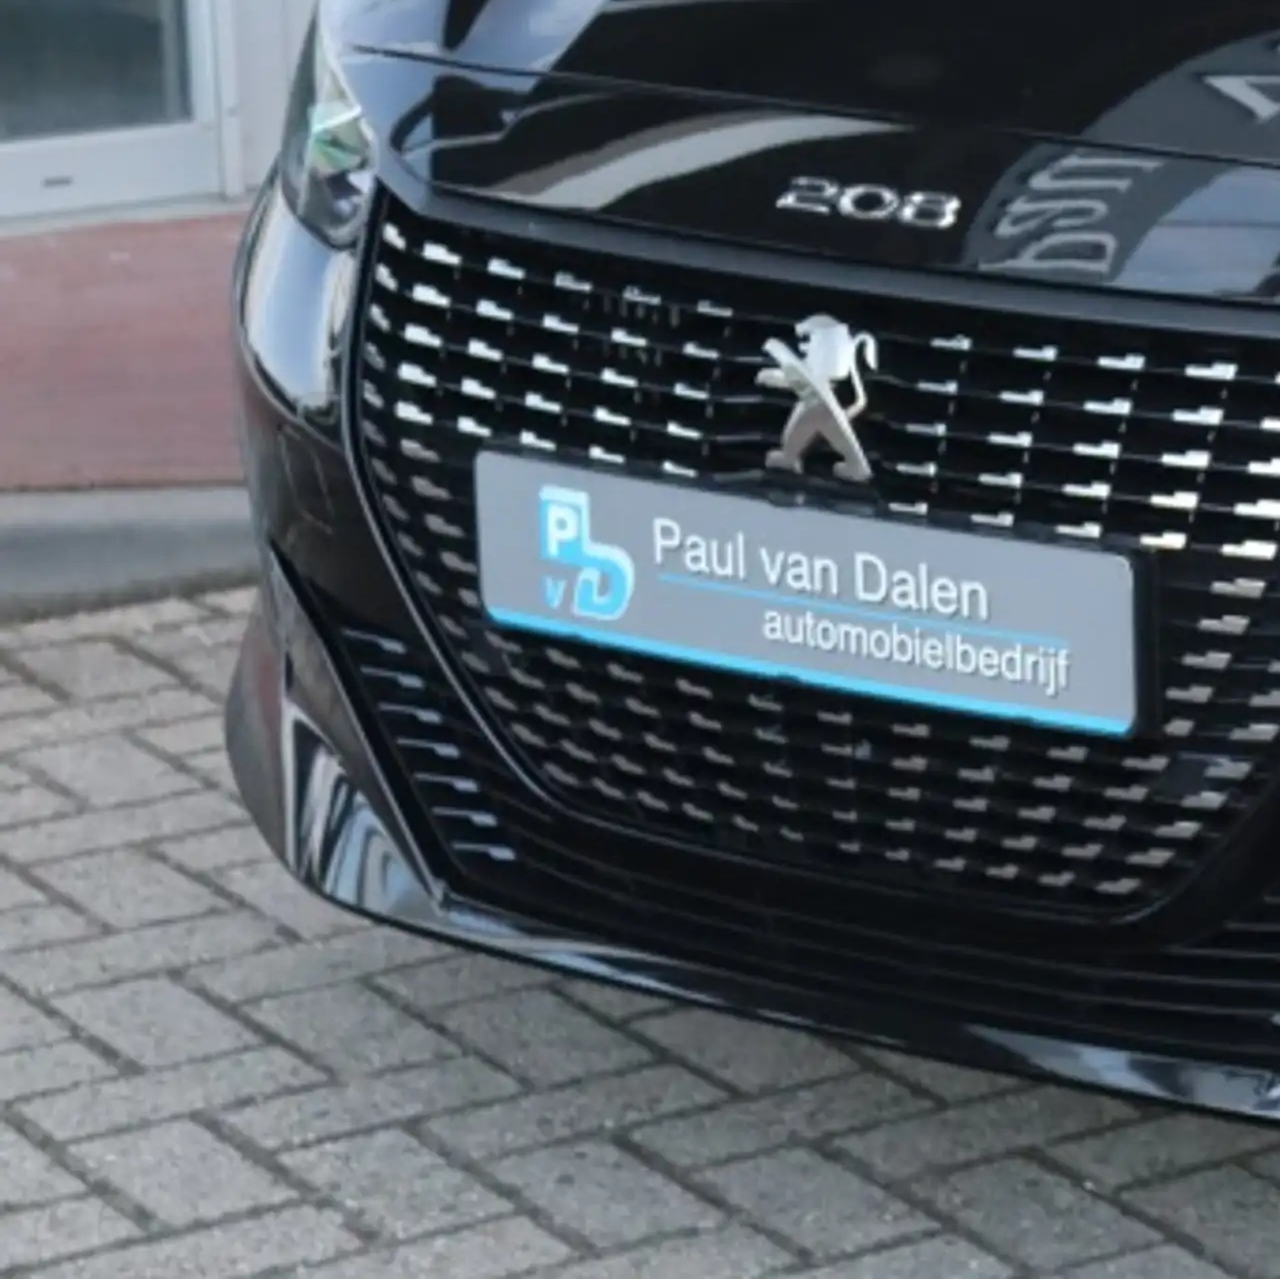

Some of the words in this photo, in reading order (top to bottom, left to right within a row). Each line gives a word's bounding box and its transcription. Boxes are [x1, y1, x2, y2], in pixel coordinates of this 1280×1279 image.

[775, 176, 962, 229] 208
[652, 517, 747, 579] Paul
[762, 546, 839, 597] van
[854, 551, 989, 620] Dalen
[763, 608, 1070, 696] automobielbedrijf
